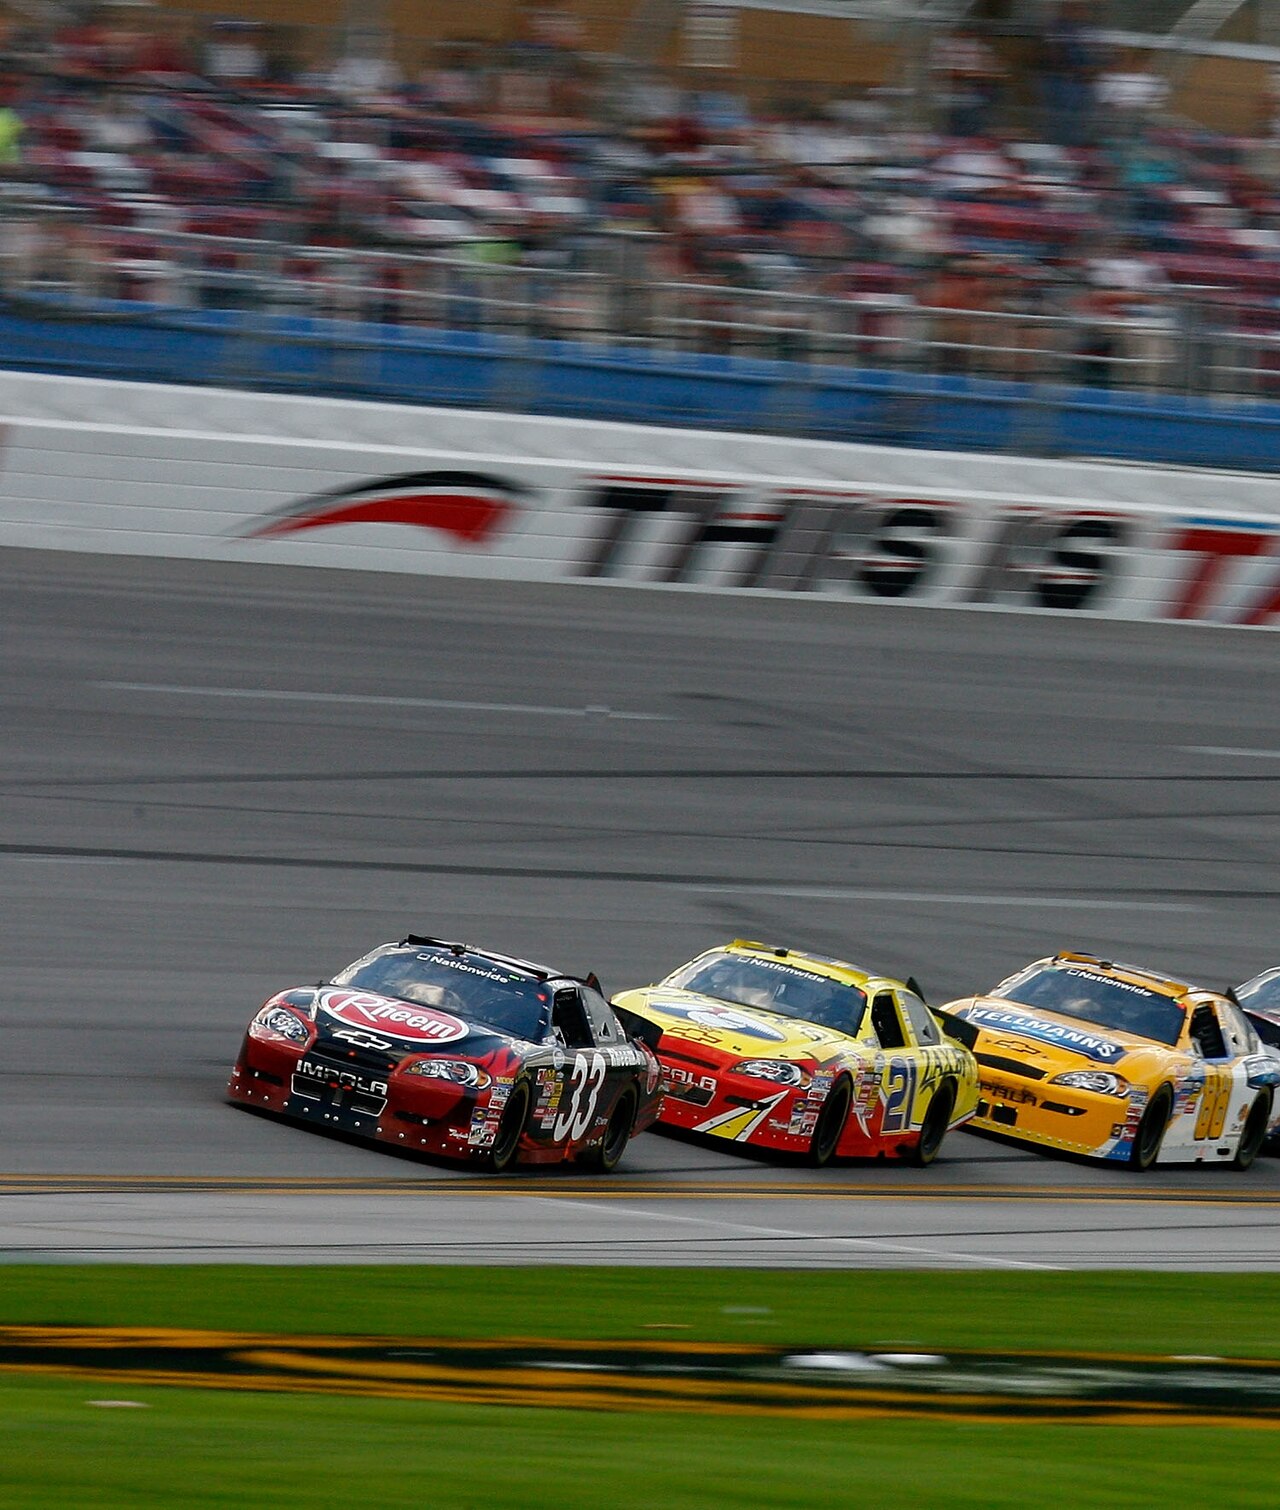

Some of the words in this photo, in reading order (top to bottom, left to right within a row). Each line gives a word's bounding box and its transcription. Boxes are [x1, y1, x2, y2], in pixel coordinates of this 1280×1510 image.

[570, 474, 962, 598] THIS
[965, 505, 1140, 611] IS
[430, 955, 509, 984] Nationwide
[750, 958, 826, 983] Nationwide
[1078, 970, 1153, 998] Nationwide
[330, 995, 457, 1039] Rheem
[295, 1060, 388, 1096] IMPALA
[553, 1053, 607, 1142] 33
[880, 1055, 918, 1134] 21
